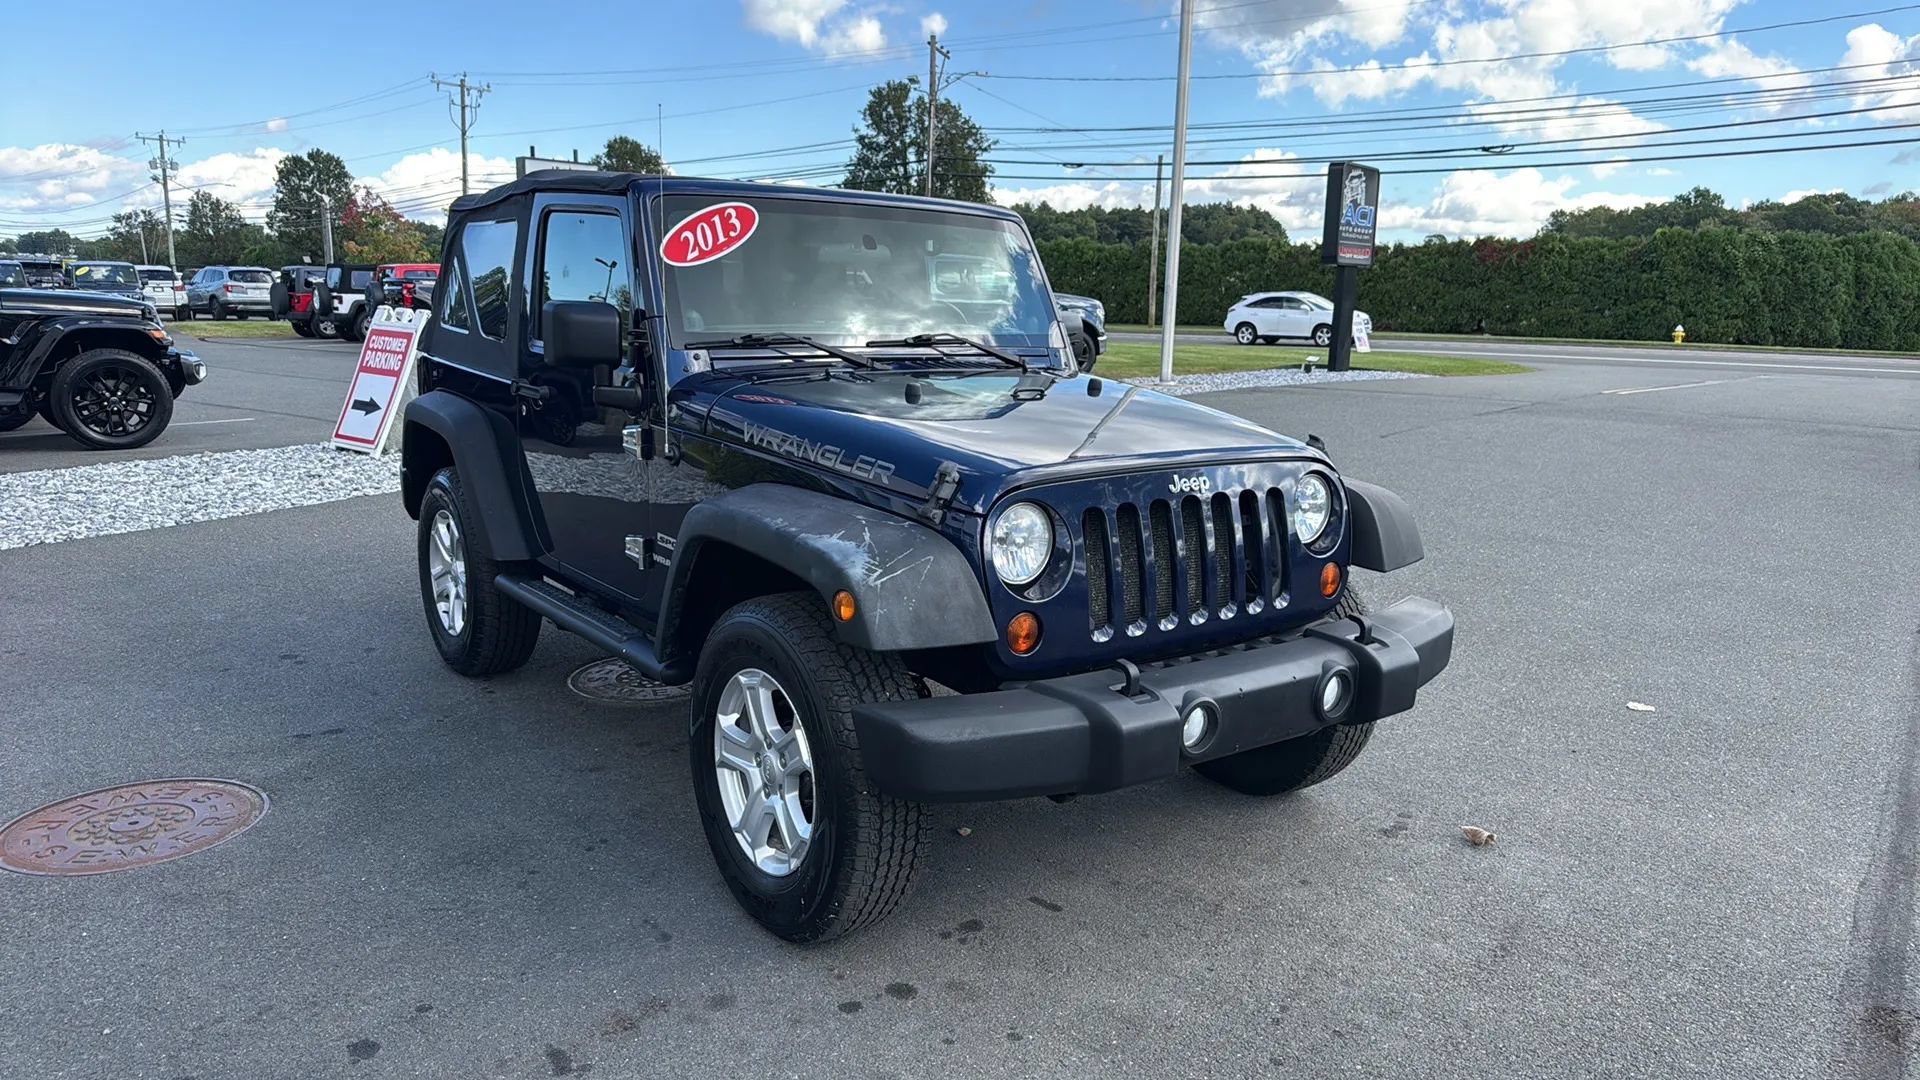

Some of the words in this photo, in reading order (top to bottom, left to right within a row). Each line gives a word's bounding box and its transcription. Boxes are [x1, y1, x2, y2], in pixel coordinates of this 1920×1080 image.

[1341, 202, 1375, 226] ACI
[680, 207, 741, 262] 2013
[369, 335, 408, 353] CUSTOMER
[362, 350, 403, 371] PARKING
[743, 421, 896, 485] WRANGLER
[1168, 474, 1210, 494] Jeep
